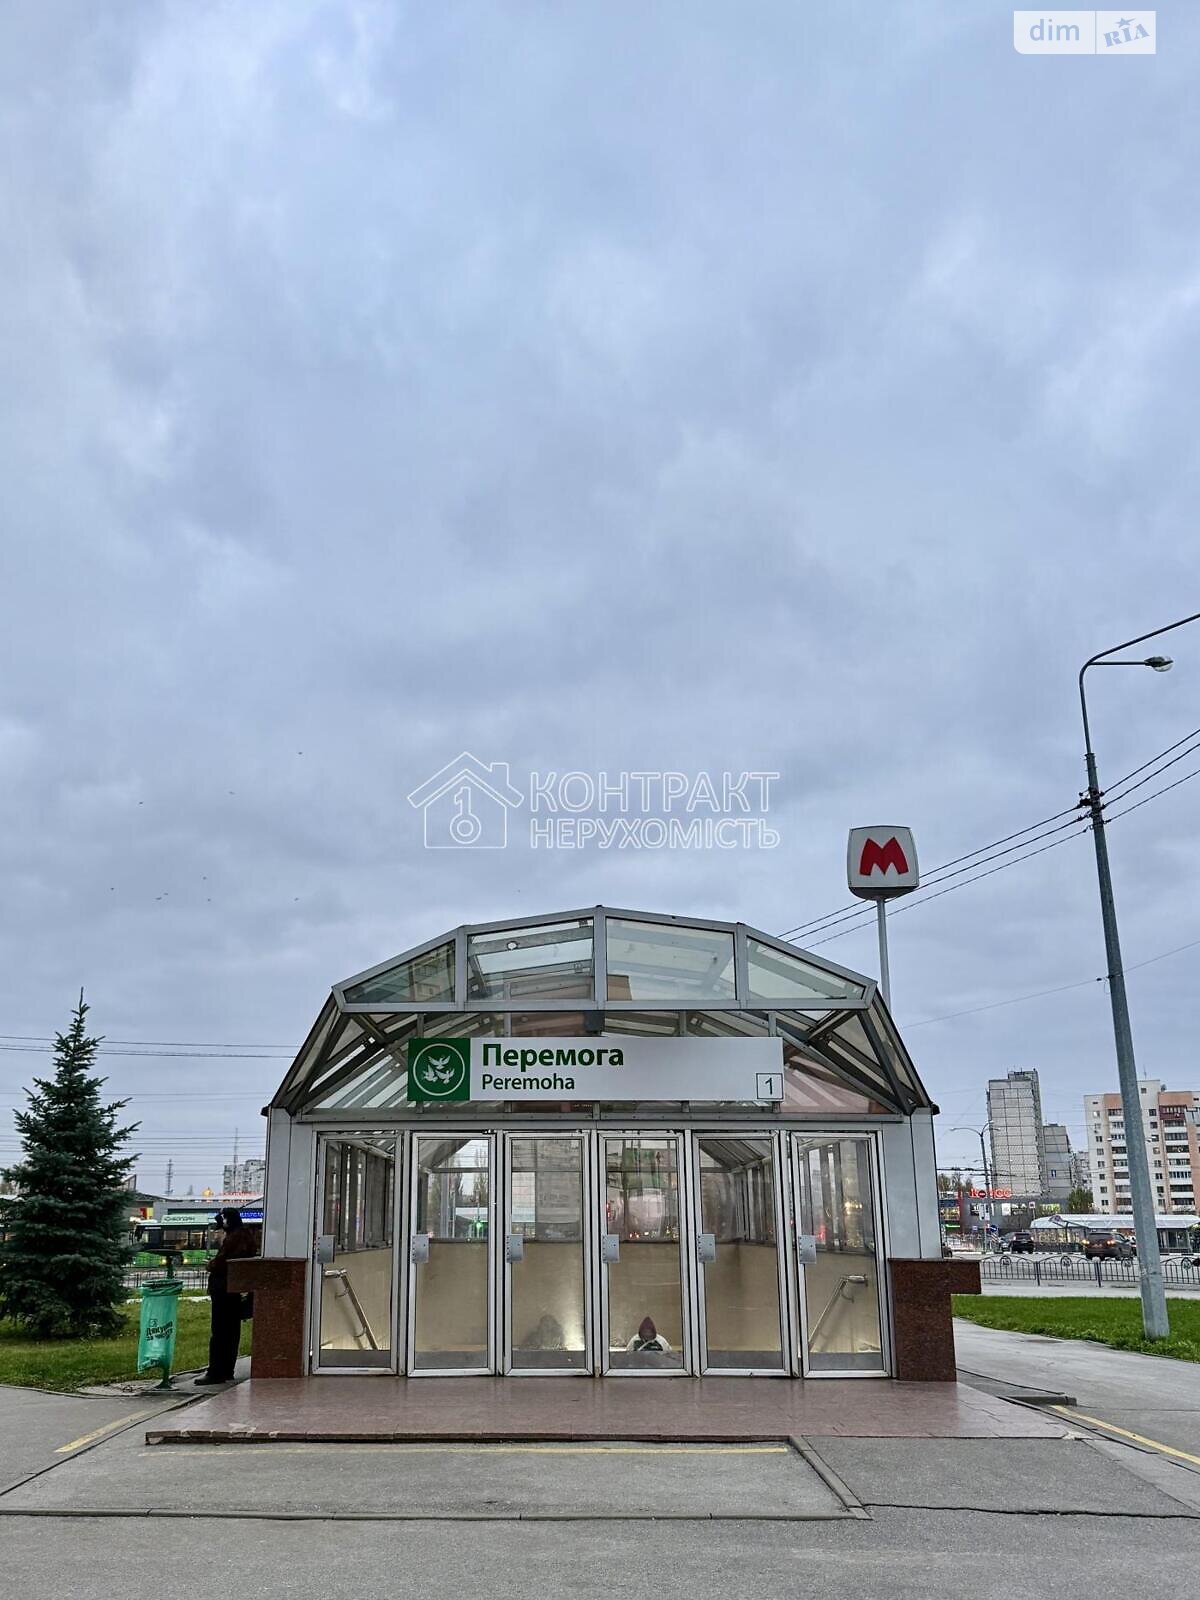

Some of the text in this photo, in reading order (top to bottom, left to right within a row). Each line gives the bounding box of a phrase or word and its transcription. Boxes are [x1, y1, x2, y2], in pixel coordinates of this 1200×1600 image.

[482, 1043, 624, 1072] Перемога
[482, 1073, 575, 1090] Peremoha
[765, 1077, 773, 1095] 1
